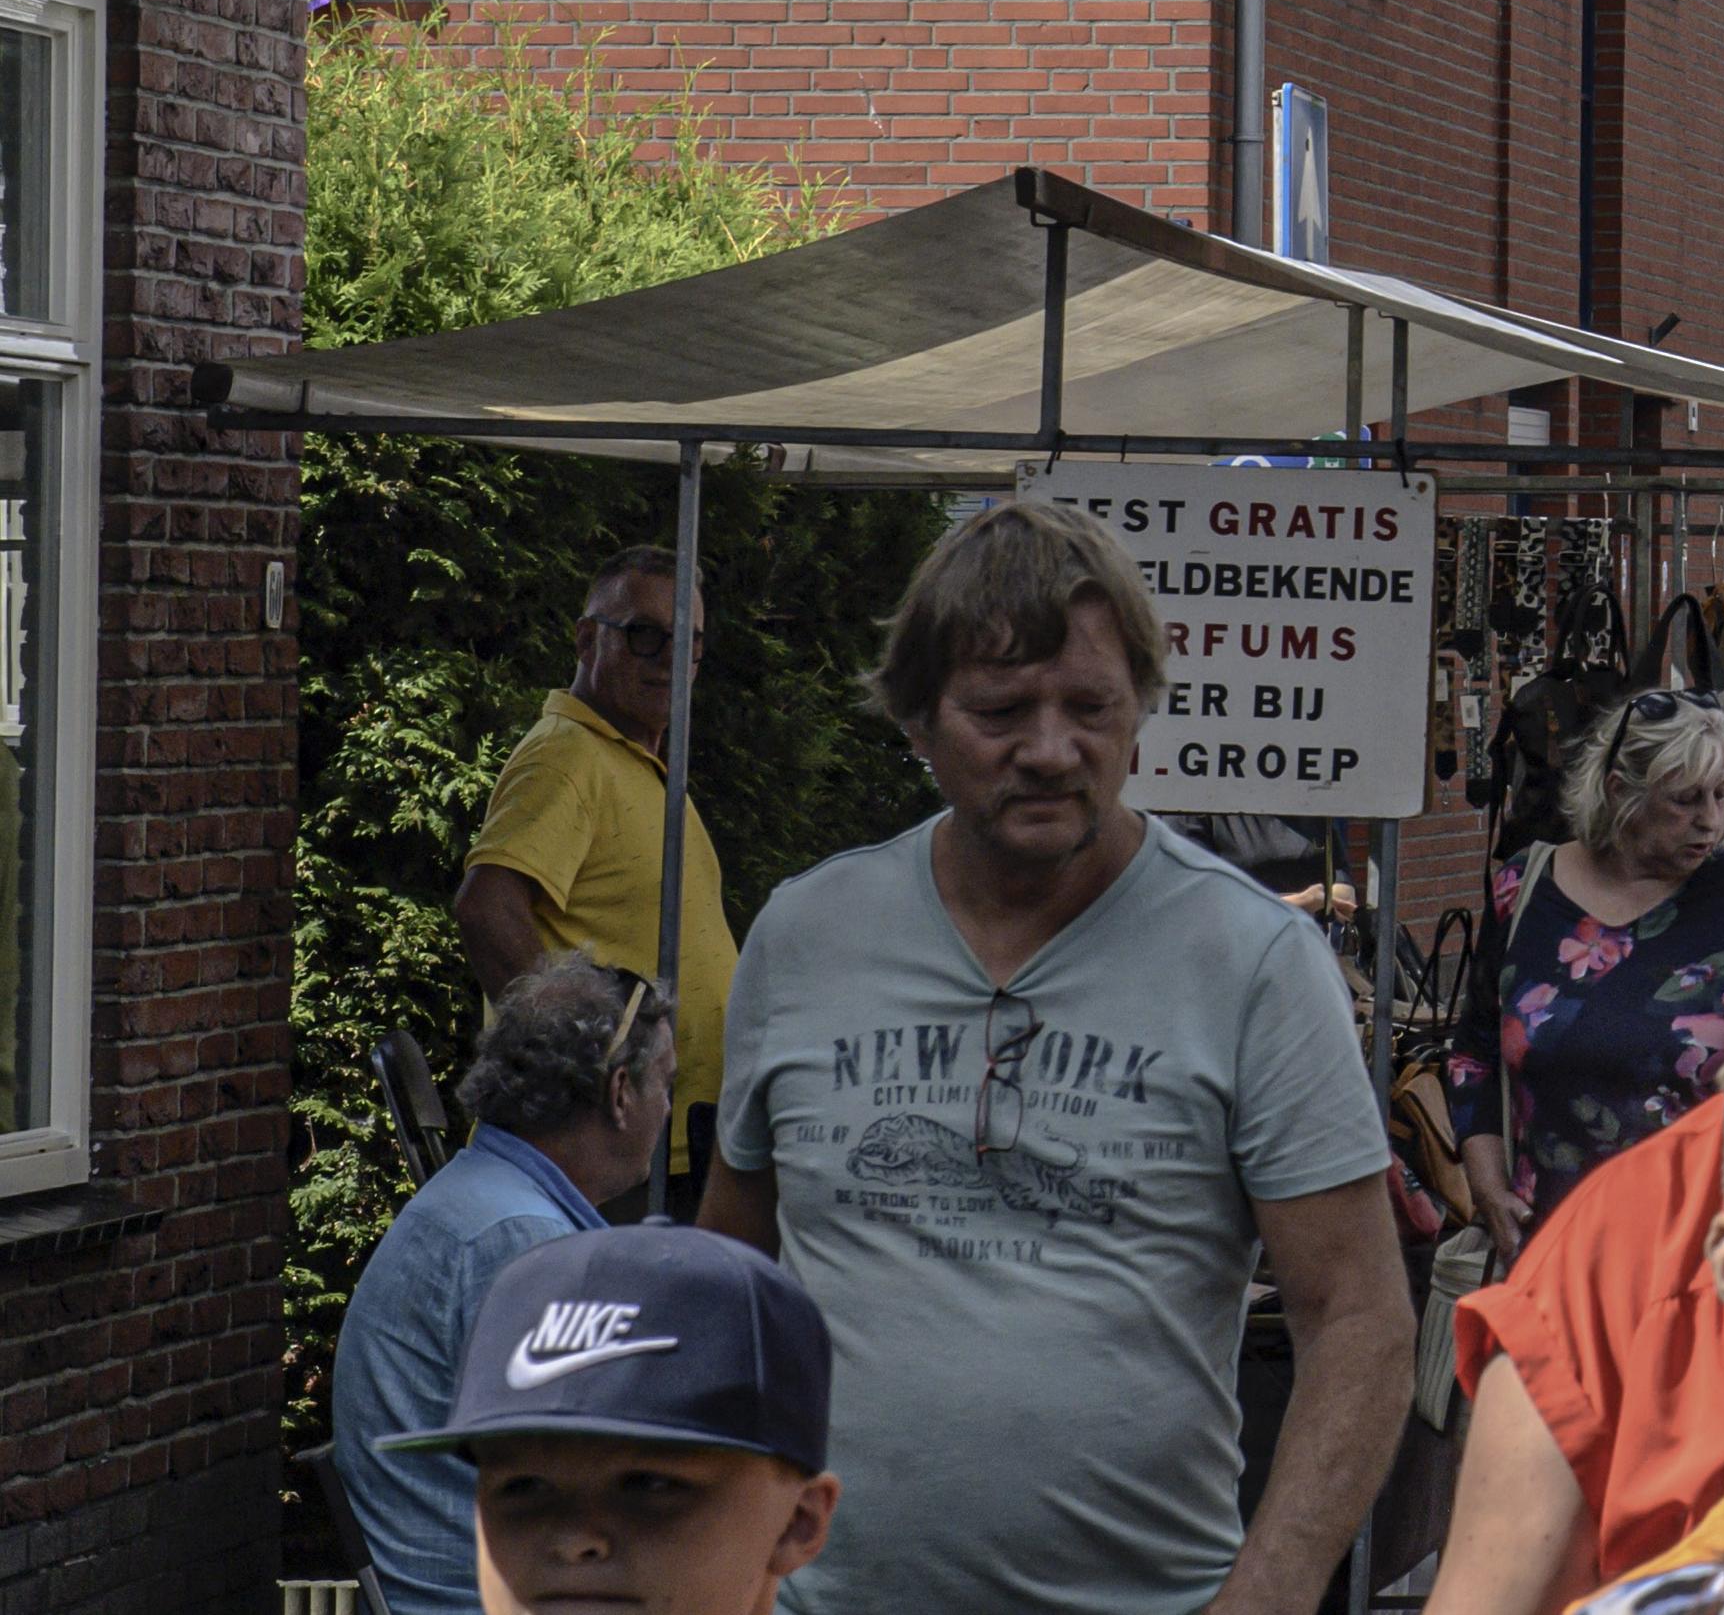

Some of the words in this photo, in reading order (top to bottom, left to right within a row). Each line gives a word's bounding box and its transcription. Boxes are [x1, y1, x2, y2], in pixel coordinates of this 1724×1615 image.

[1053, 497, 1186, 533] EST
[1210, 501, 1399, 542] GRATIS
[1150, 683, 1229, 717] ER
[1254, 685, 1324, 721] BIJ
[833, 1025, 967, 1091] NEW
[1004, 1024, 1165, 1103] YORK
[873, 1086, 917, 1106] CITY
[1026, 1088, 1099, 1116] DITION
[858, 1190, 920, 1208] STRONG
[928, 1195, 950, 1211] TO
[957, 1196, 997, 1212] LOVE
[917, 1235, 1042, 1263] BROOKLYN
[531, 1301, 641, 1352] NIKE
